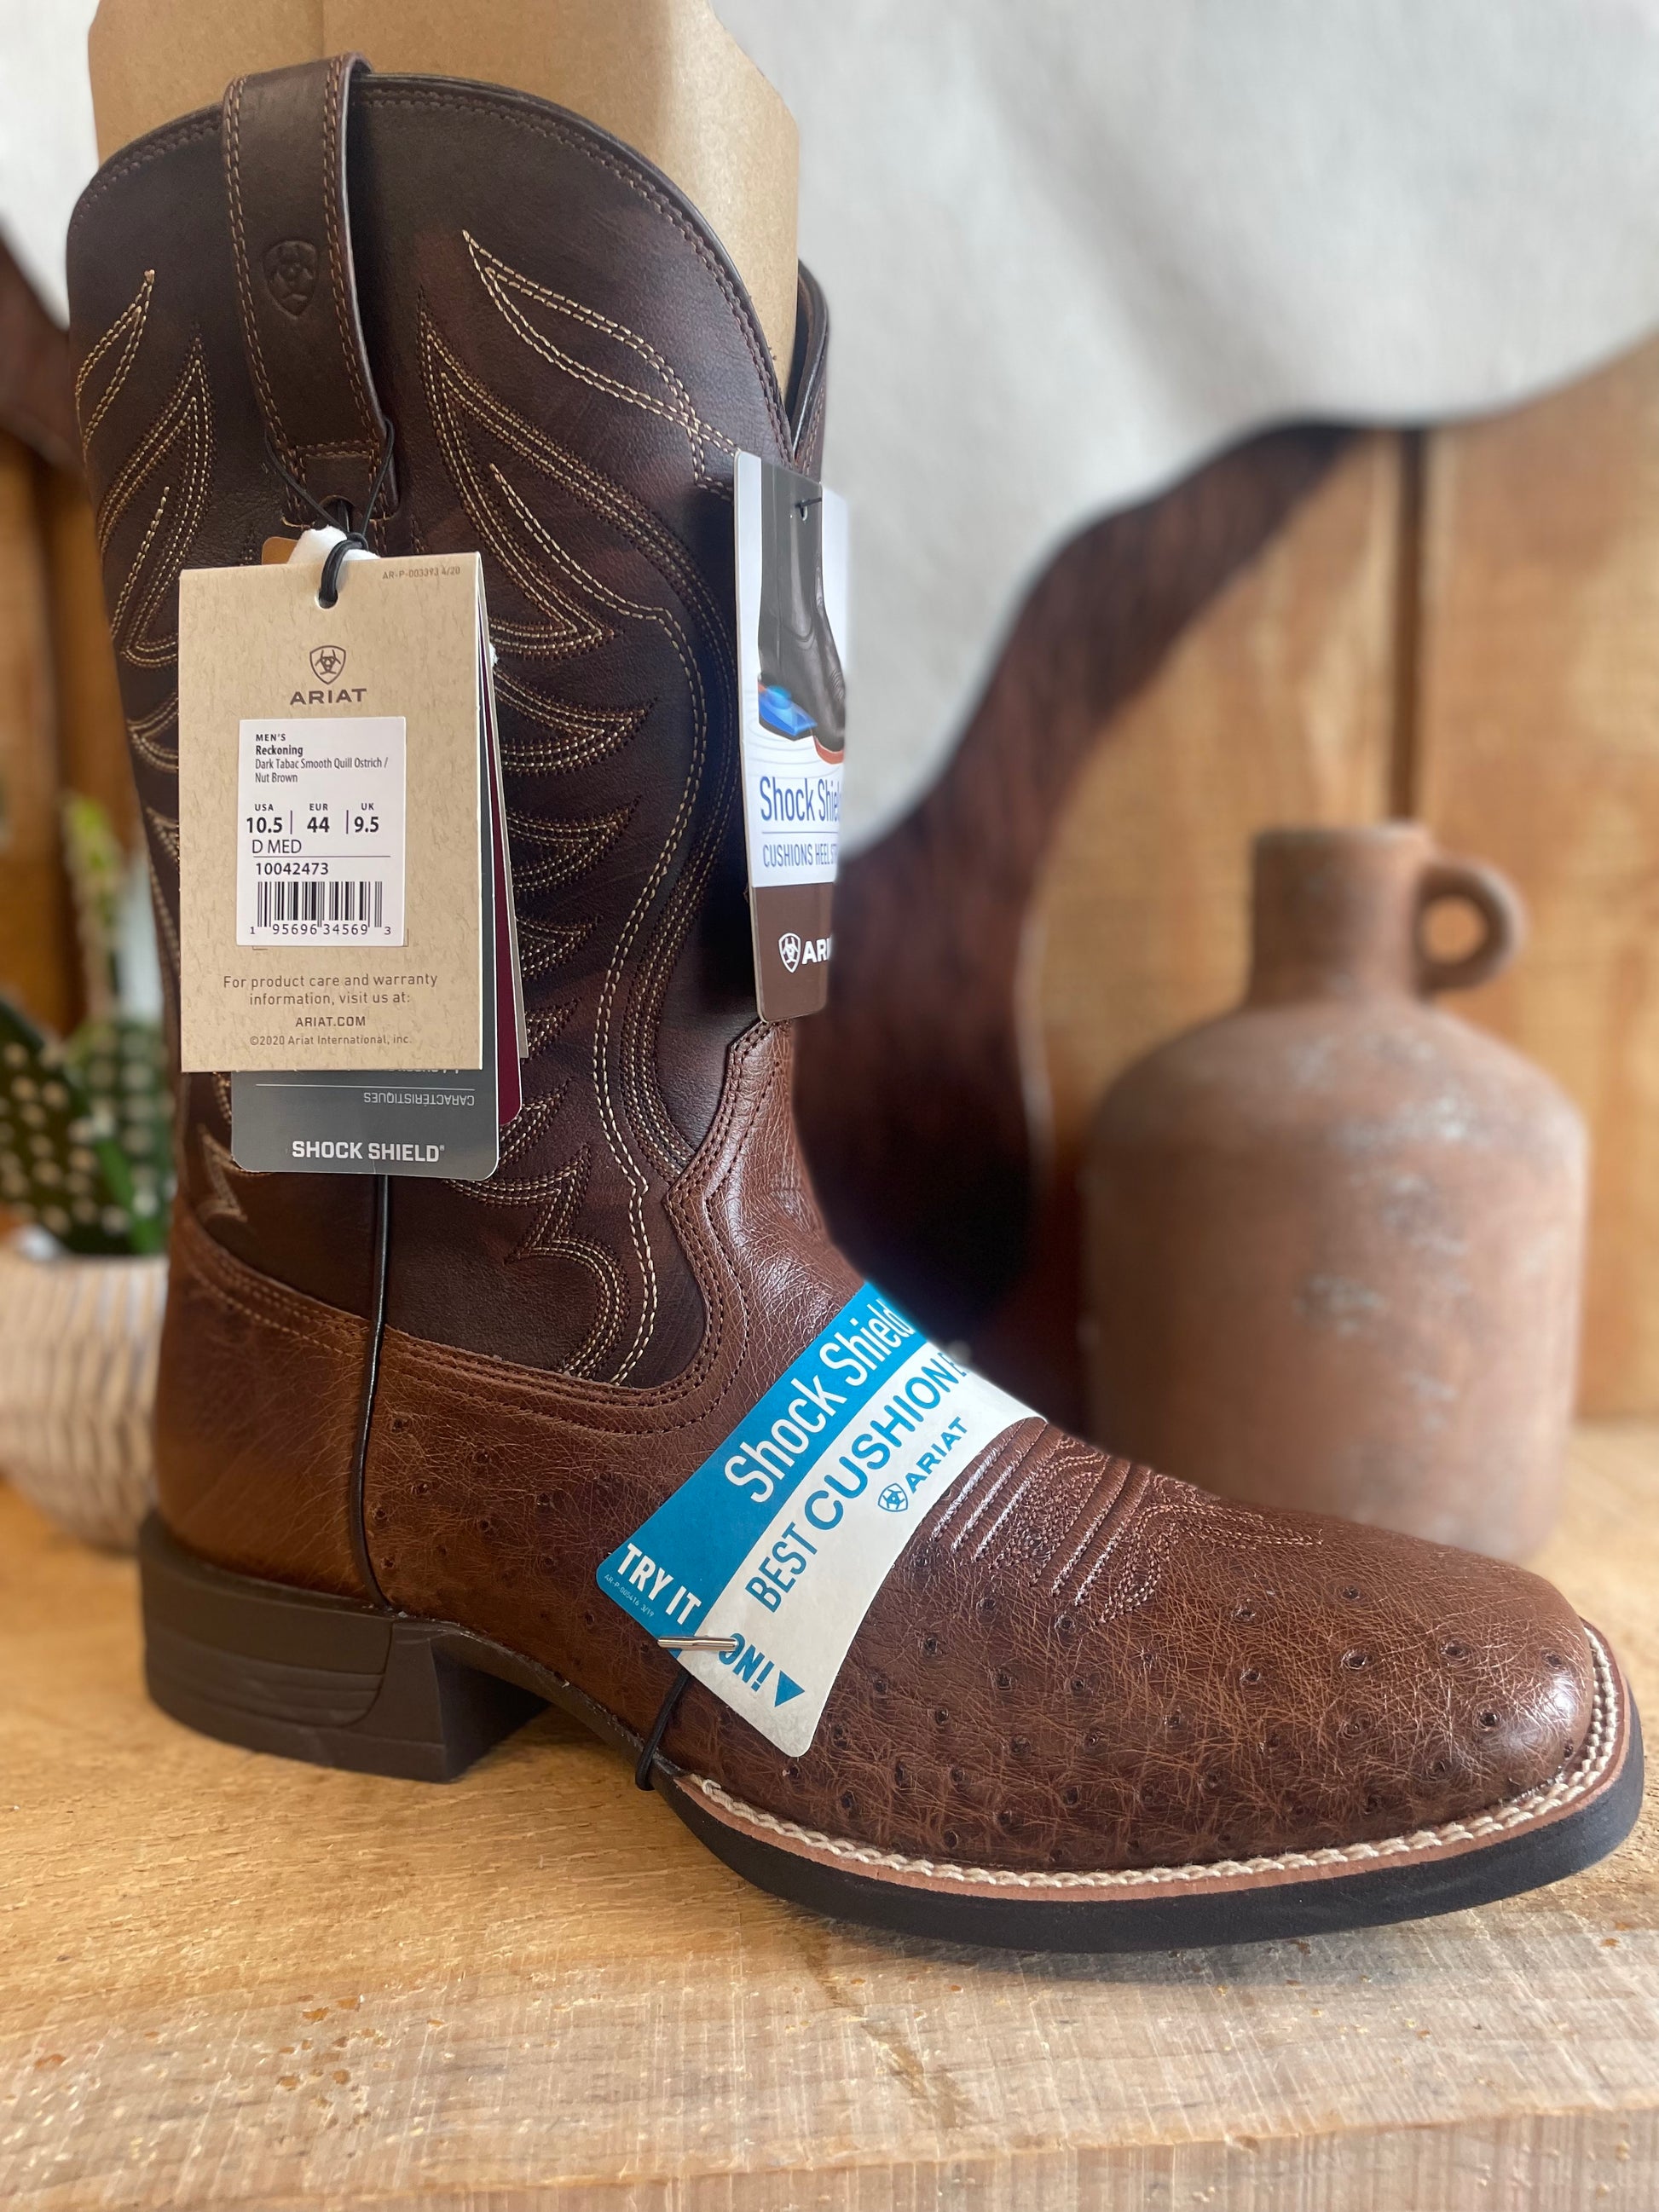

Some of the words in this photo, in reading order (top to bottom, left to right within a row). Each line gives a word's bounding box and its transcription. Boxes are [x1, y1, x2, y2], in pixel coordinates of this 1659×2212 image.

[290, 688, 367, 706] ARIAT
[256, 733, 286, 742] MEN'S
[256, 745, 303, 757] Reckoning
[255, 758, 274, 769] Dark
[275, 758, 299, 769] Tabac
[301, 757, 332, 769] Smooth
[334, 757, 352, 770] Quill
[354, 757, 382, 768] Ostrich
[255, 772, 270, 783] Nut
[271, 772, 298, 783] Brown
[760, 776, 816, 821] Shock
[361, 802, 375, 811] UK
[246, 817, 283, 834] 10.5
[307, 817, 330, 833] 44
[354, 816, 379, 833] 9.5
[251, 839, 263, 854] D
[268, 839, 302, 854] MED
[763, 843, 813, 868] CUSHIONS
[814, 843, 830, 865] HEEL
[256, 863, 329, 875] 10042473
[250, 926, 255, 935] 1
[272, 923, 318, 935] 95696
[322, 923, 368, 935] 34569
[384, 926, 391, 935] 3
[223, 975, 247, 988] For
[251, 974, 305, 991] product
[309, 976, 340, 987] care
[344, 974, 369, 987] and
[373, 973, 438, 989] warranty
[249, 992, 335, 1006] information,
[339, 991, 368, 1004] visit
[373, 993, 390, 1004] us
[393, 992, 411, 1004] at:
[295, 1016, 366, 1027] ARIAT.COM
[250, 1034, 286, 1046] ©2020
[287, 1034, 315, 1046] Ariat
[316, 1034, 390, 1046] International,
[363, 1092, 475, 1106] CARACTÉRISTIQUES
[292, 1141, 363, 1160] SHOCK
[724, 1374, 847, 1503] Shock
[820, 1297, 916, 1386] Shield
[905, 1416, 968, 1494] ARIAT
[745, 1522, 818, 1613] BEST
[616, 1543, 673, 1601] TRY
[665, 1585, 702, 1626] IT
